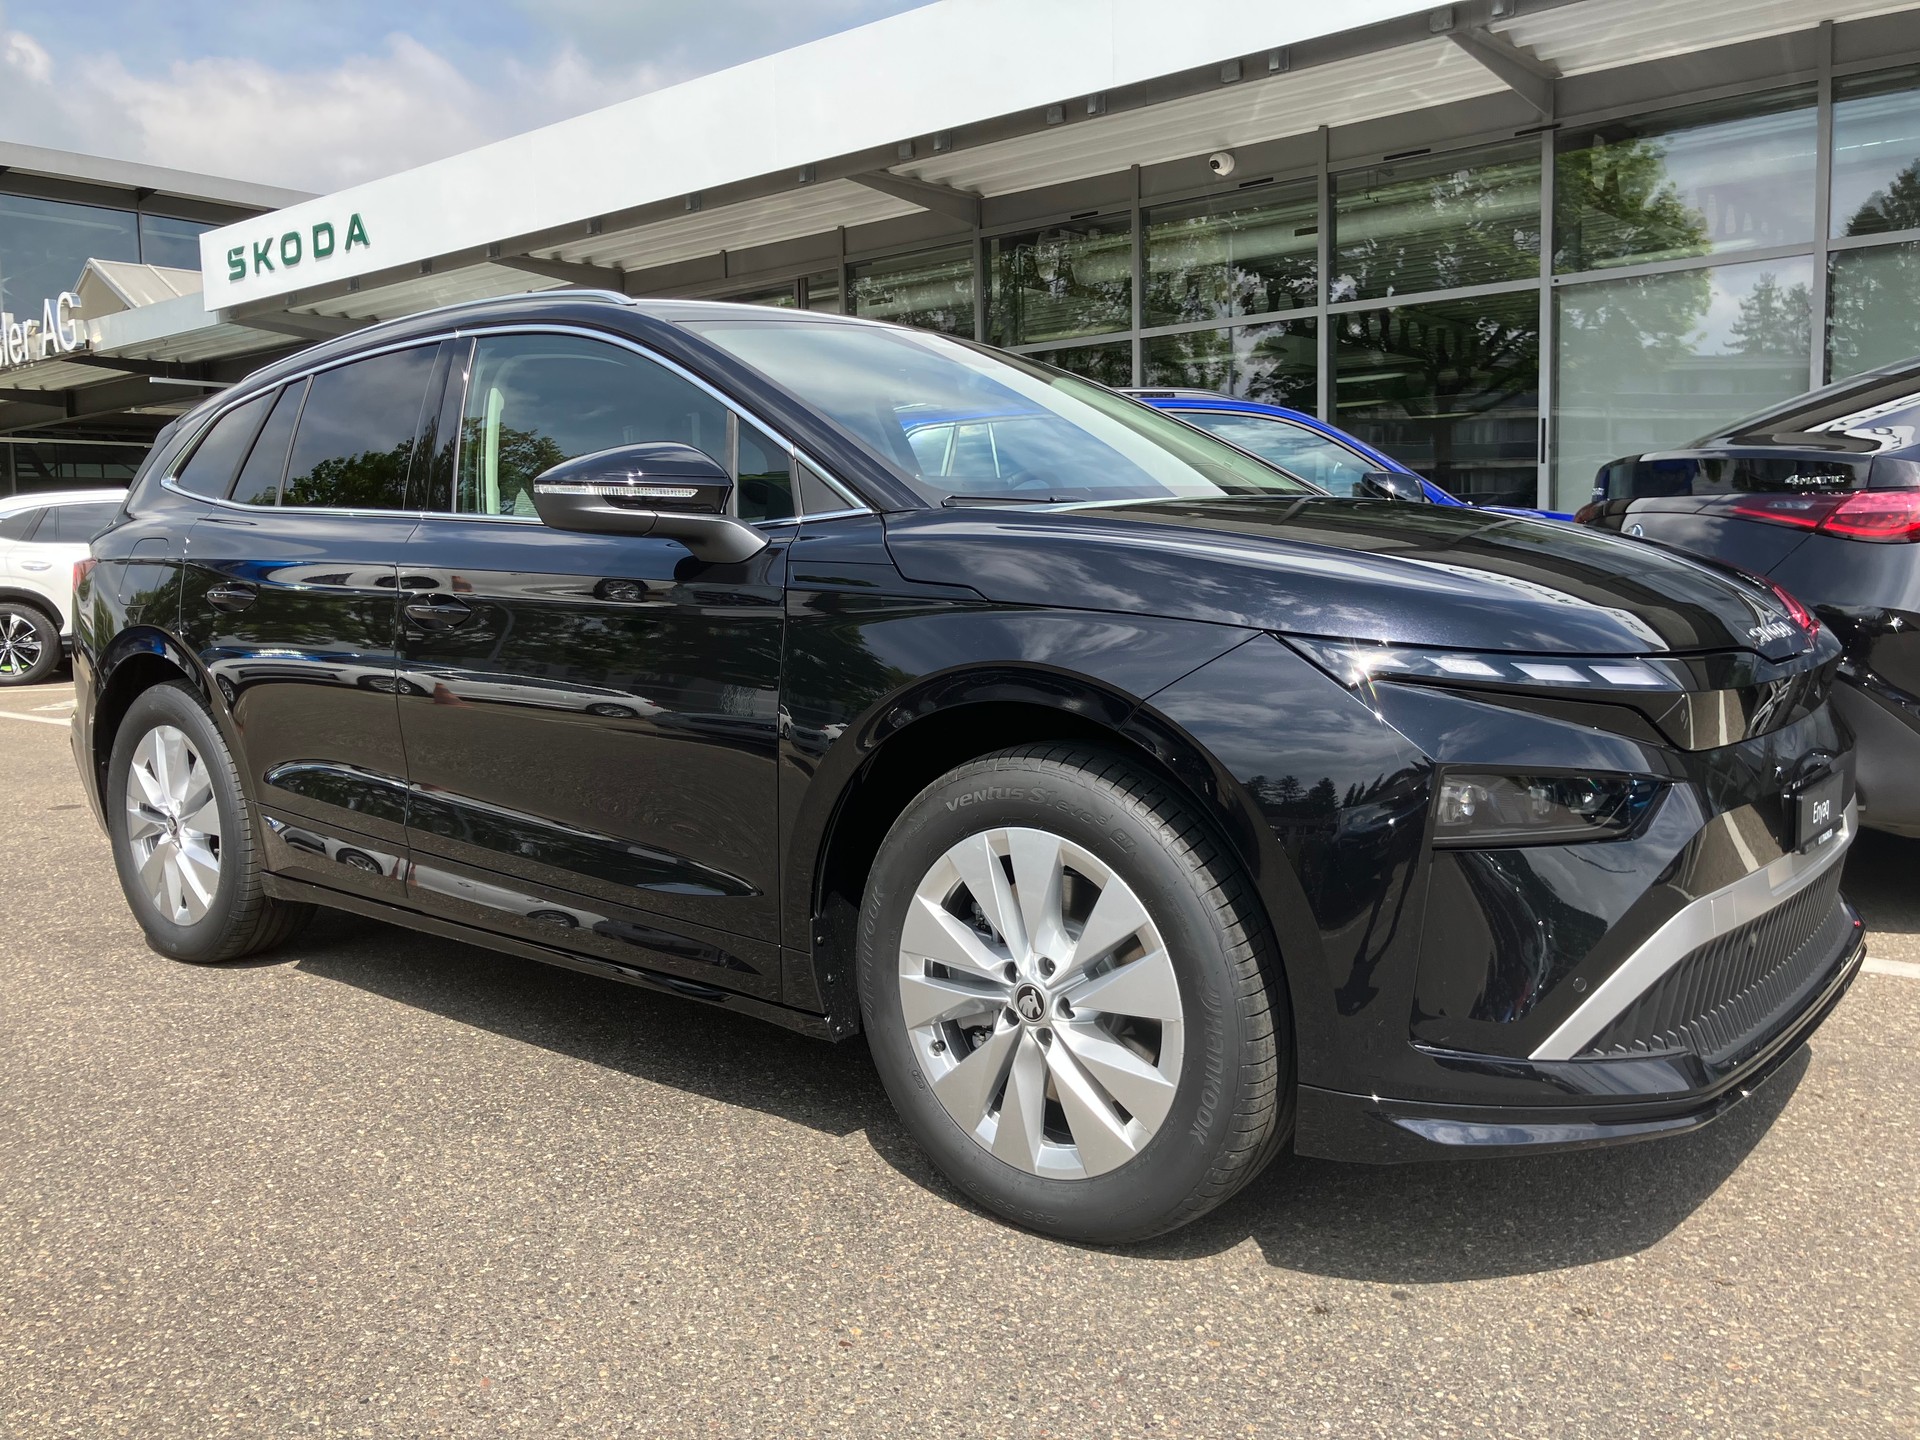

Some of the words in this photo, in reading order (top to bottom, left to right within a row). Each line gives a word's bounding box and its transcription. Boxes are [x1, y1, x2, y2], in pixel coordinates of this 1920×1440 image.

[227, 213, 370, 281] SKODA
[0, 312, 36, 367] ler
[42, 292, 80, 355] AG
[1785, 474, 1845, 485] 4MATIC
[1813, 799, 1830, 825] Enyaq
